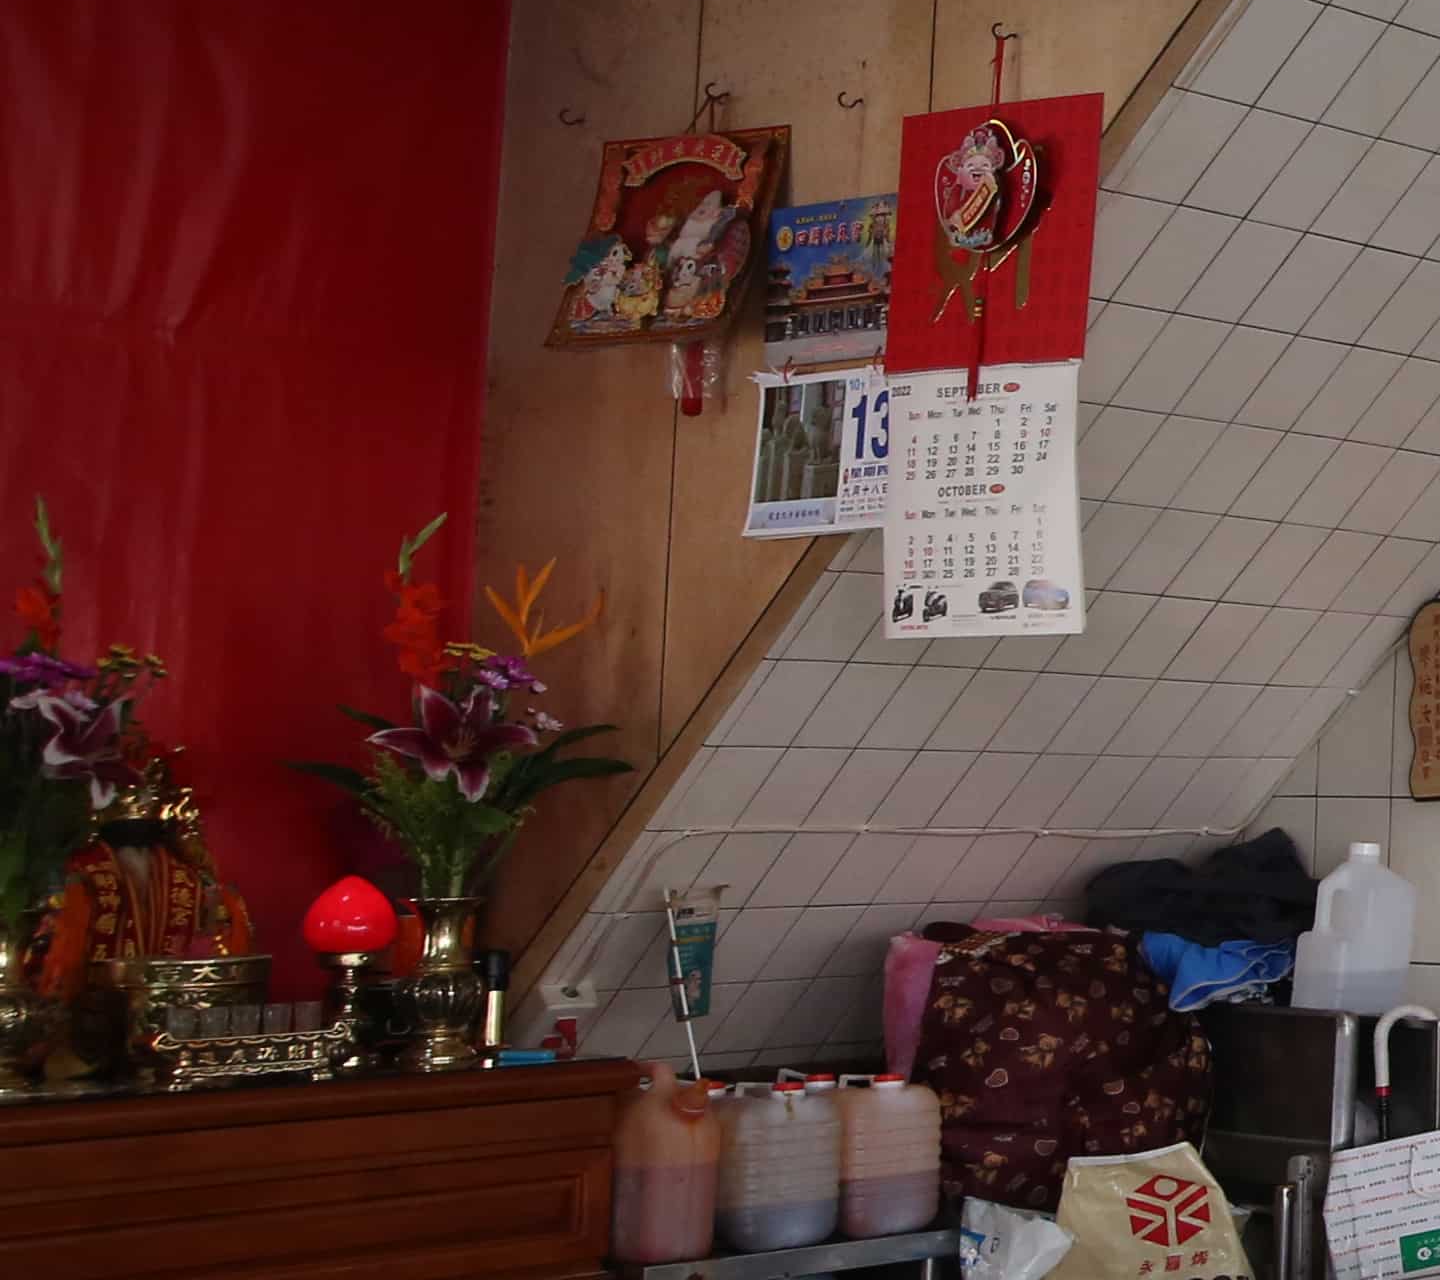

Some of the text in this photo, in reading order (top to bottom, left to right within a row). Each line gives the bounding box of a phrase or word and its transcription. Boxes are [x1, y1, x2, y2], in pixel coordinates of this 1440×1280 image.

[892, 386, 911, 397] 2022
[936, 383, 1000, 399] SEPTBER
[852, 389, 889, 460] 13
[938, 485, 986, 498] OCTOBER
